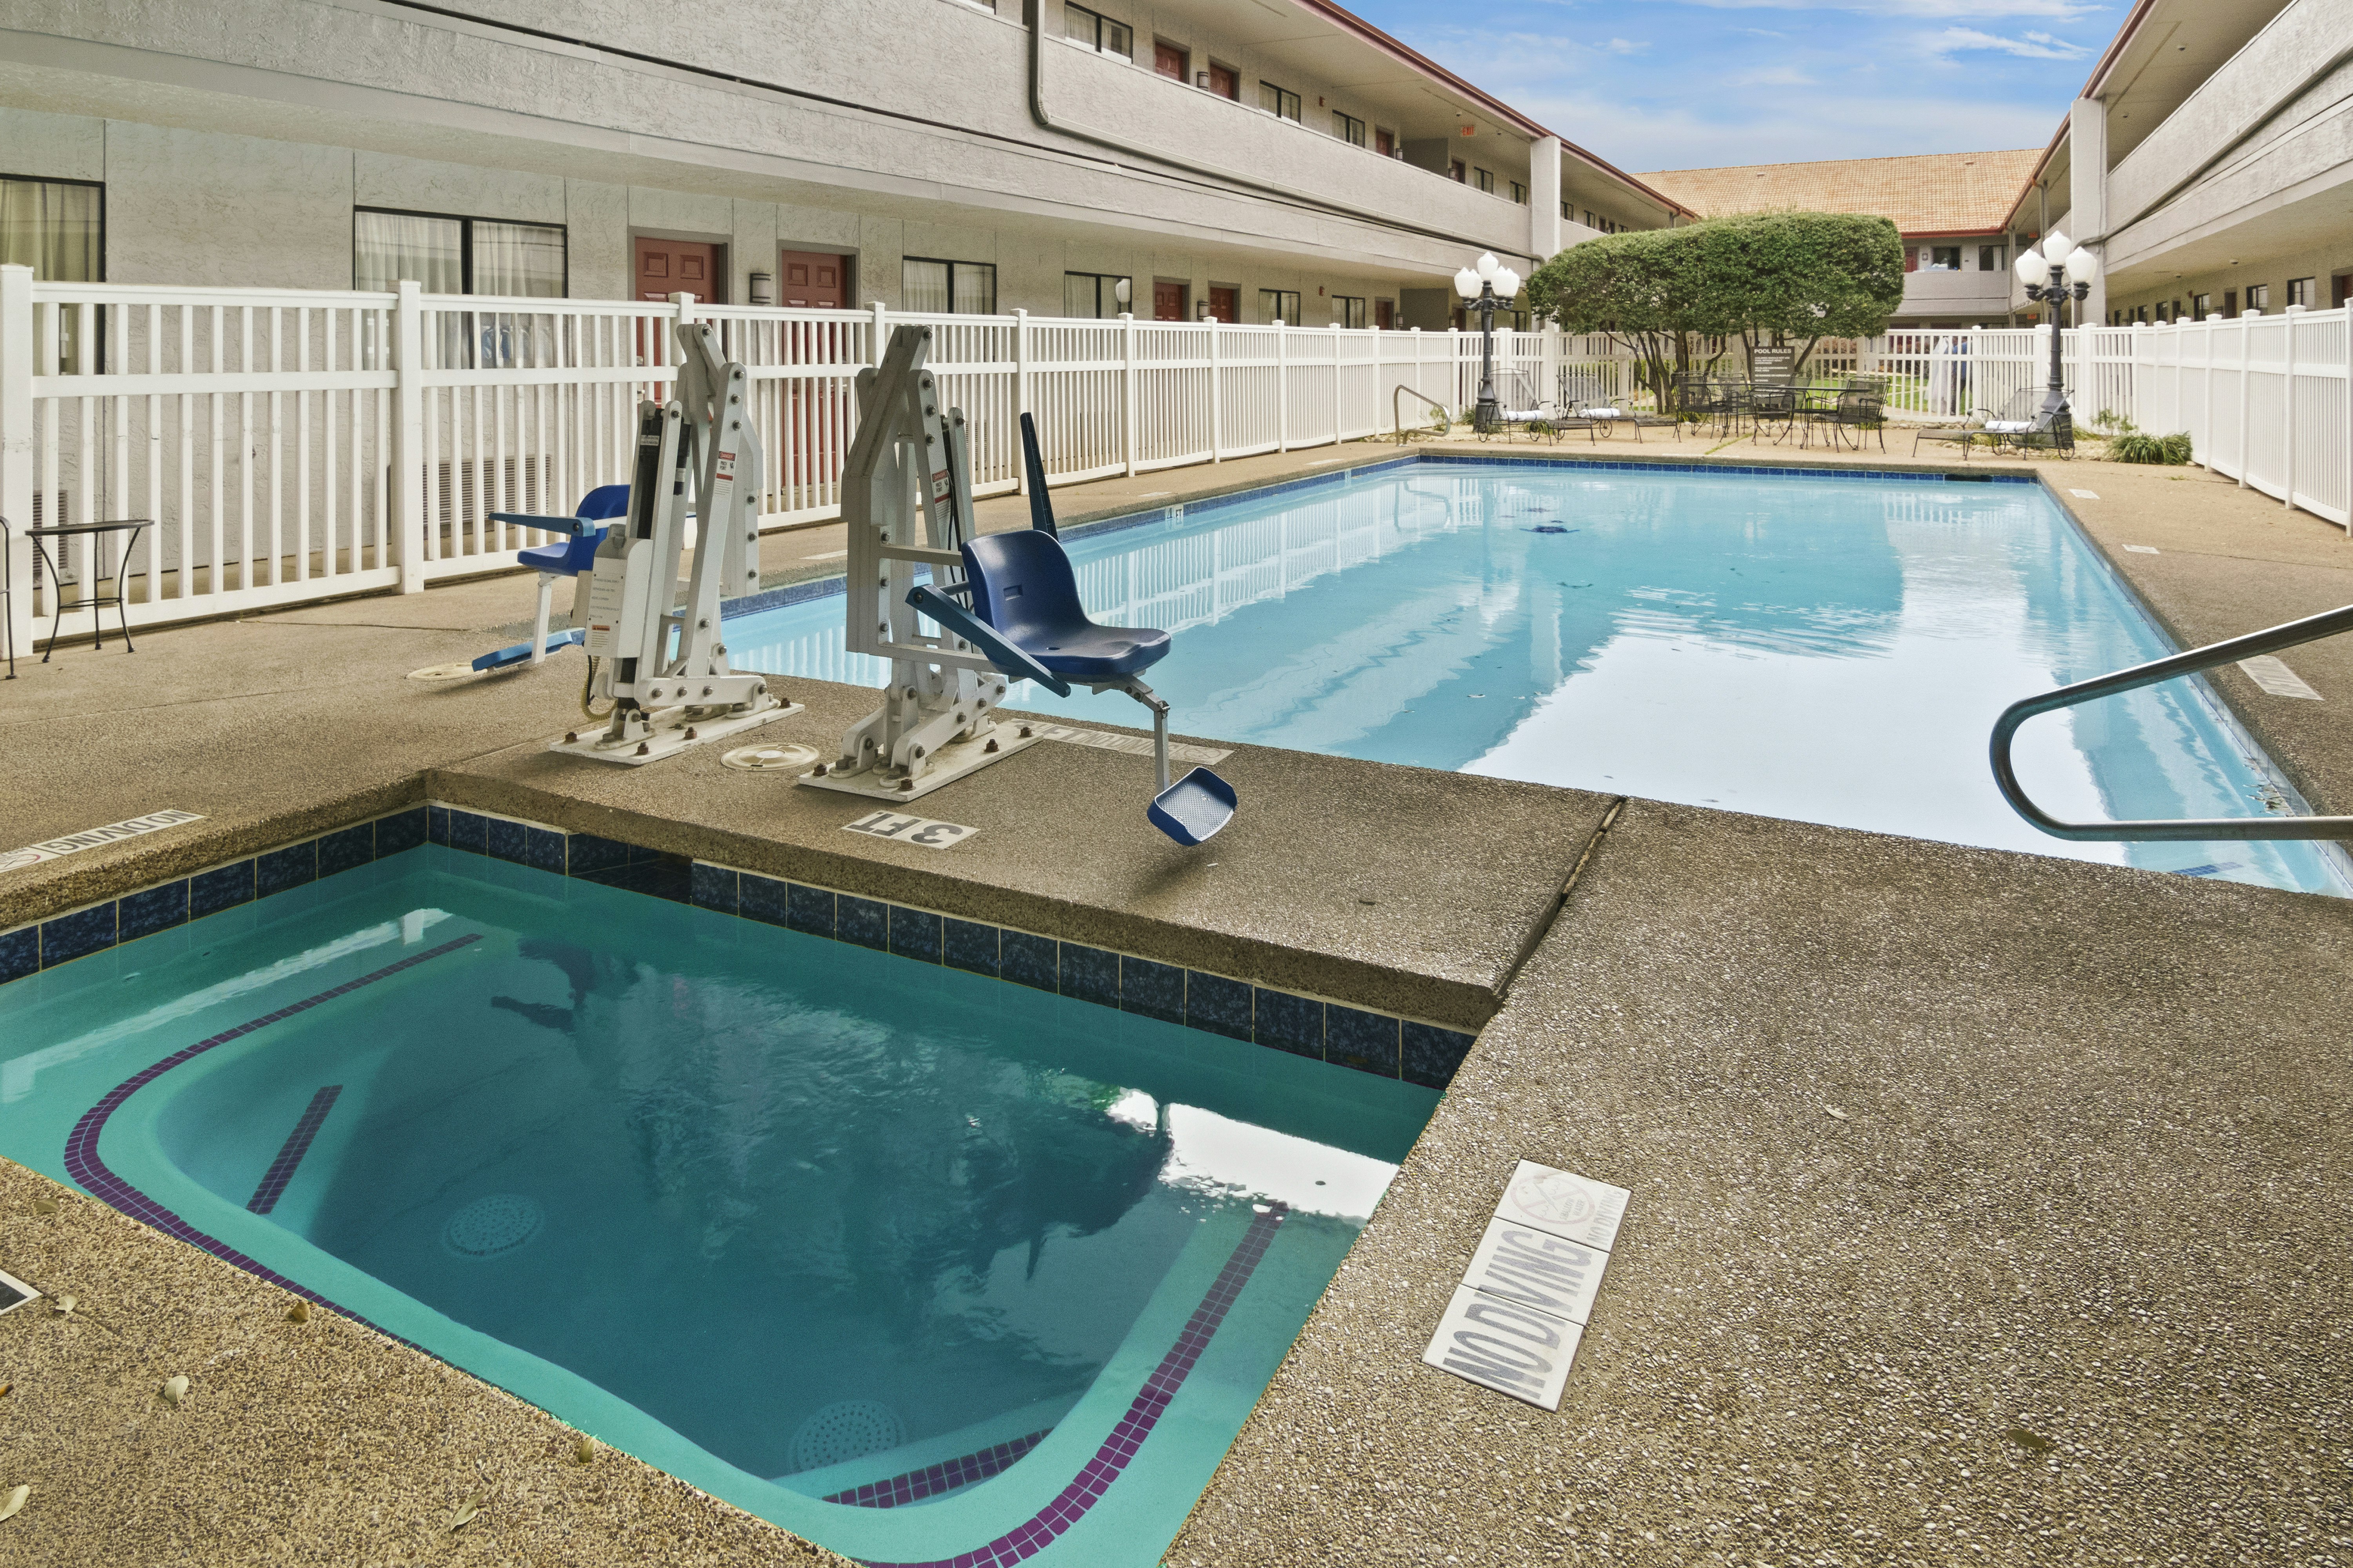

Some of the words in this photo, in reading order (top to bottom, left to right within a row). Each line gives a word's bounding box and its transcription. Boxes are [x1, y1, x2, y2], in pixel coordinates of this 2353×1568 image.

[1176, 509, 1182, 518] FT
[145, 810, 197, 823] NO
[40, 821, 159, 851] DIVING
[911, 824, 963, 844] 3
[1560, 1198, 1575, 1221] SHALLOW
[1572, 1199, 1586, 1216] WATER
[1593, 1189, 1625, 1228] DIVING
[1587, 1226, 1612, 1246] NO
[1464, 1230, 1593, 1350] DIVING
[1442, 1330, 1553, 1400] NO
